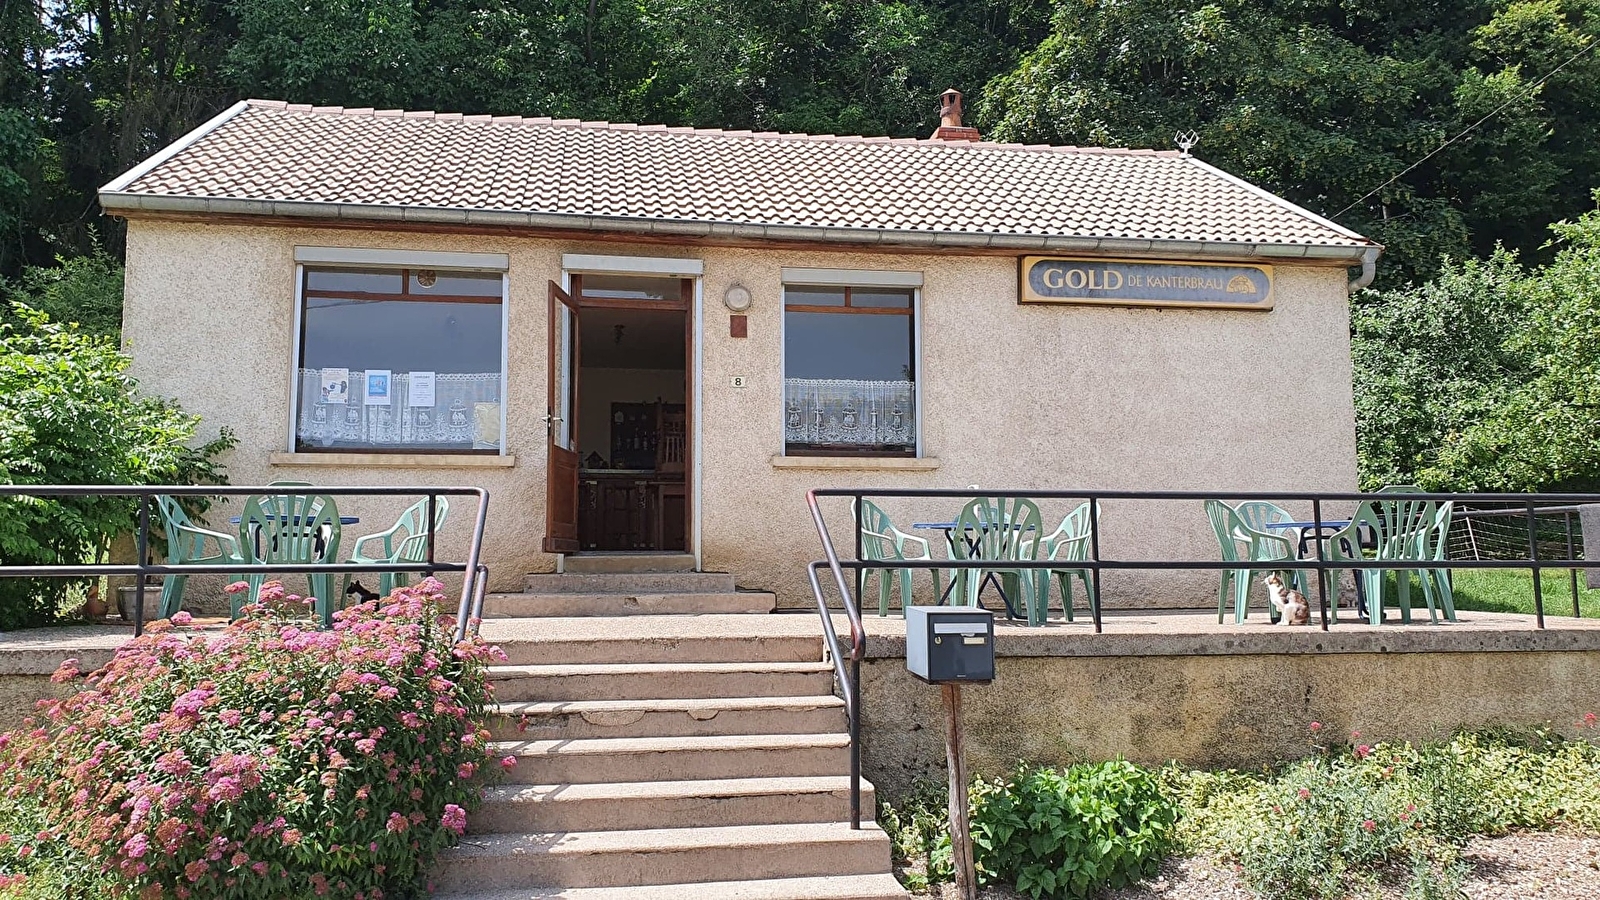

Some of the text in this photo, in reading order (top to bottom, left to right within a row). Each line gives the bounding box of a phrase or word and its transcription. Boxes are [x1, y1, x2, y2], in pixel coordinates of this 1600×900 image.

[1043, 268, 1223, 290] GOLD DE KANTERBRAU
[735, 377, 742, 386] 8
